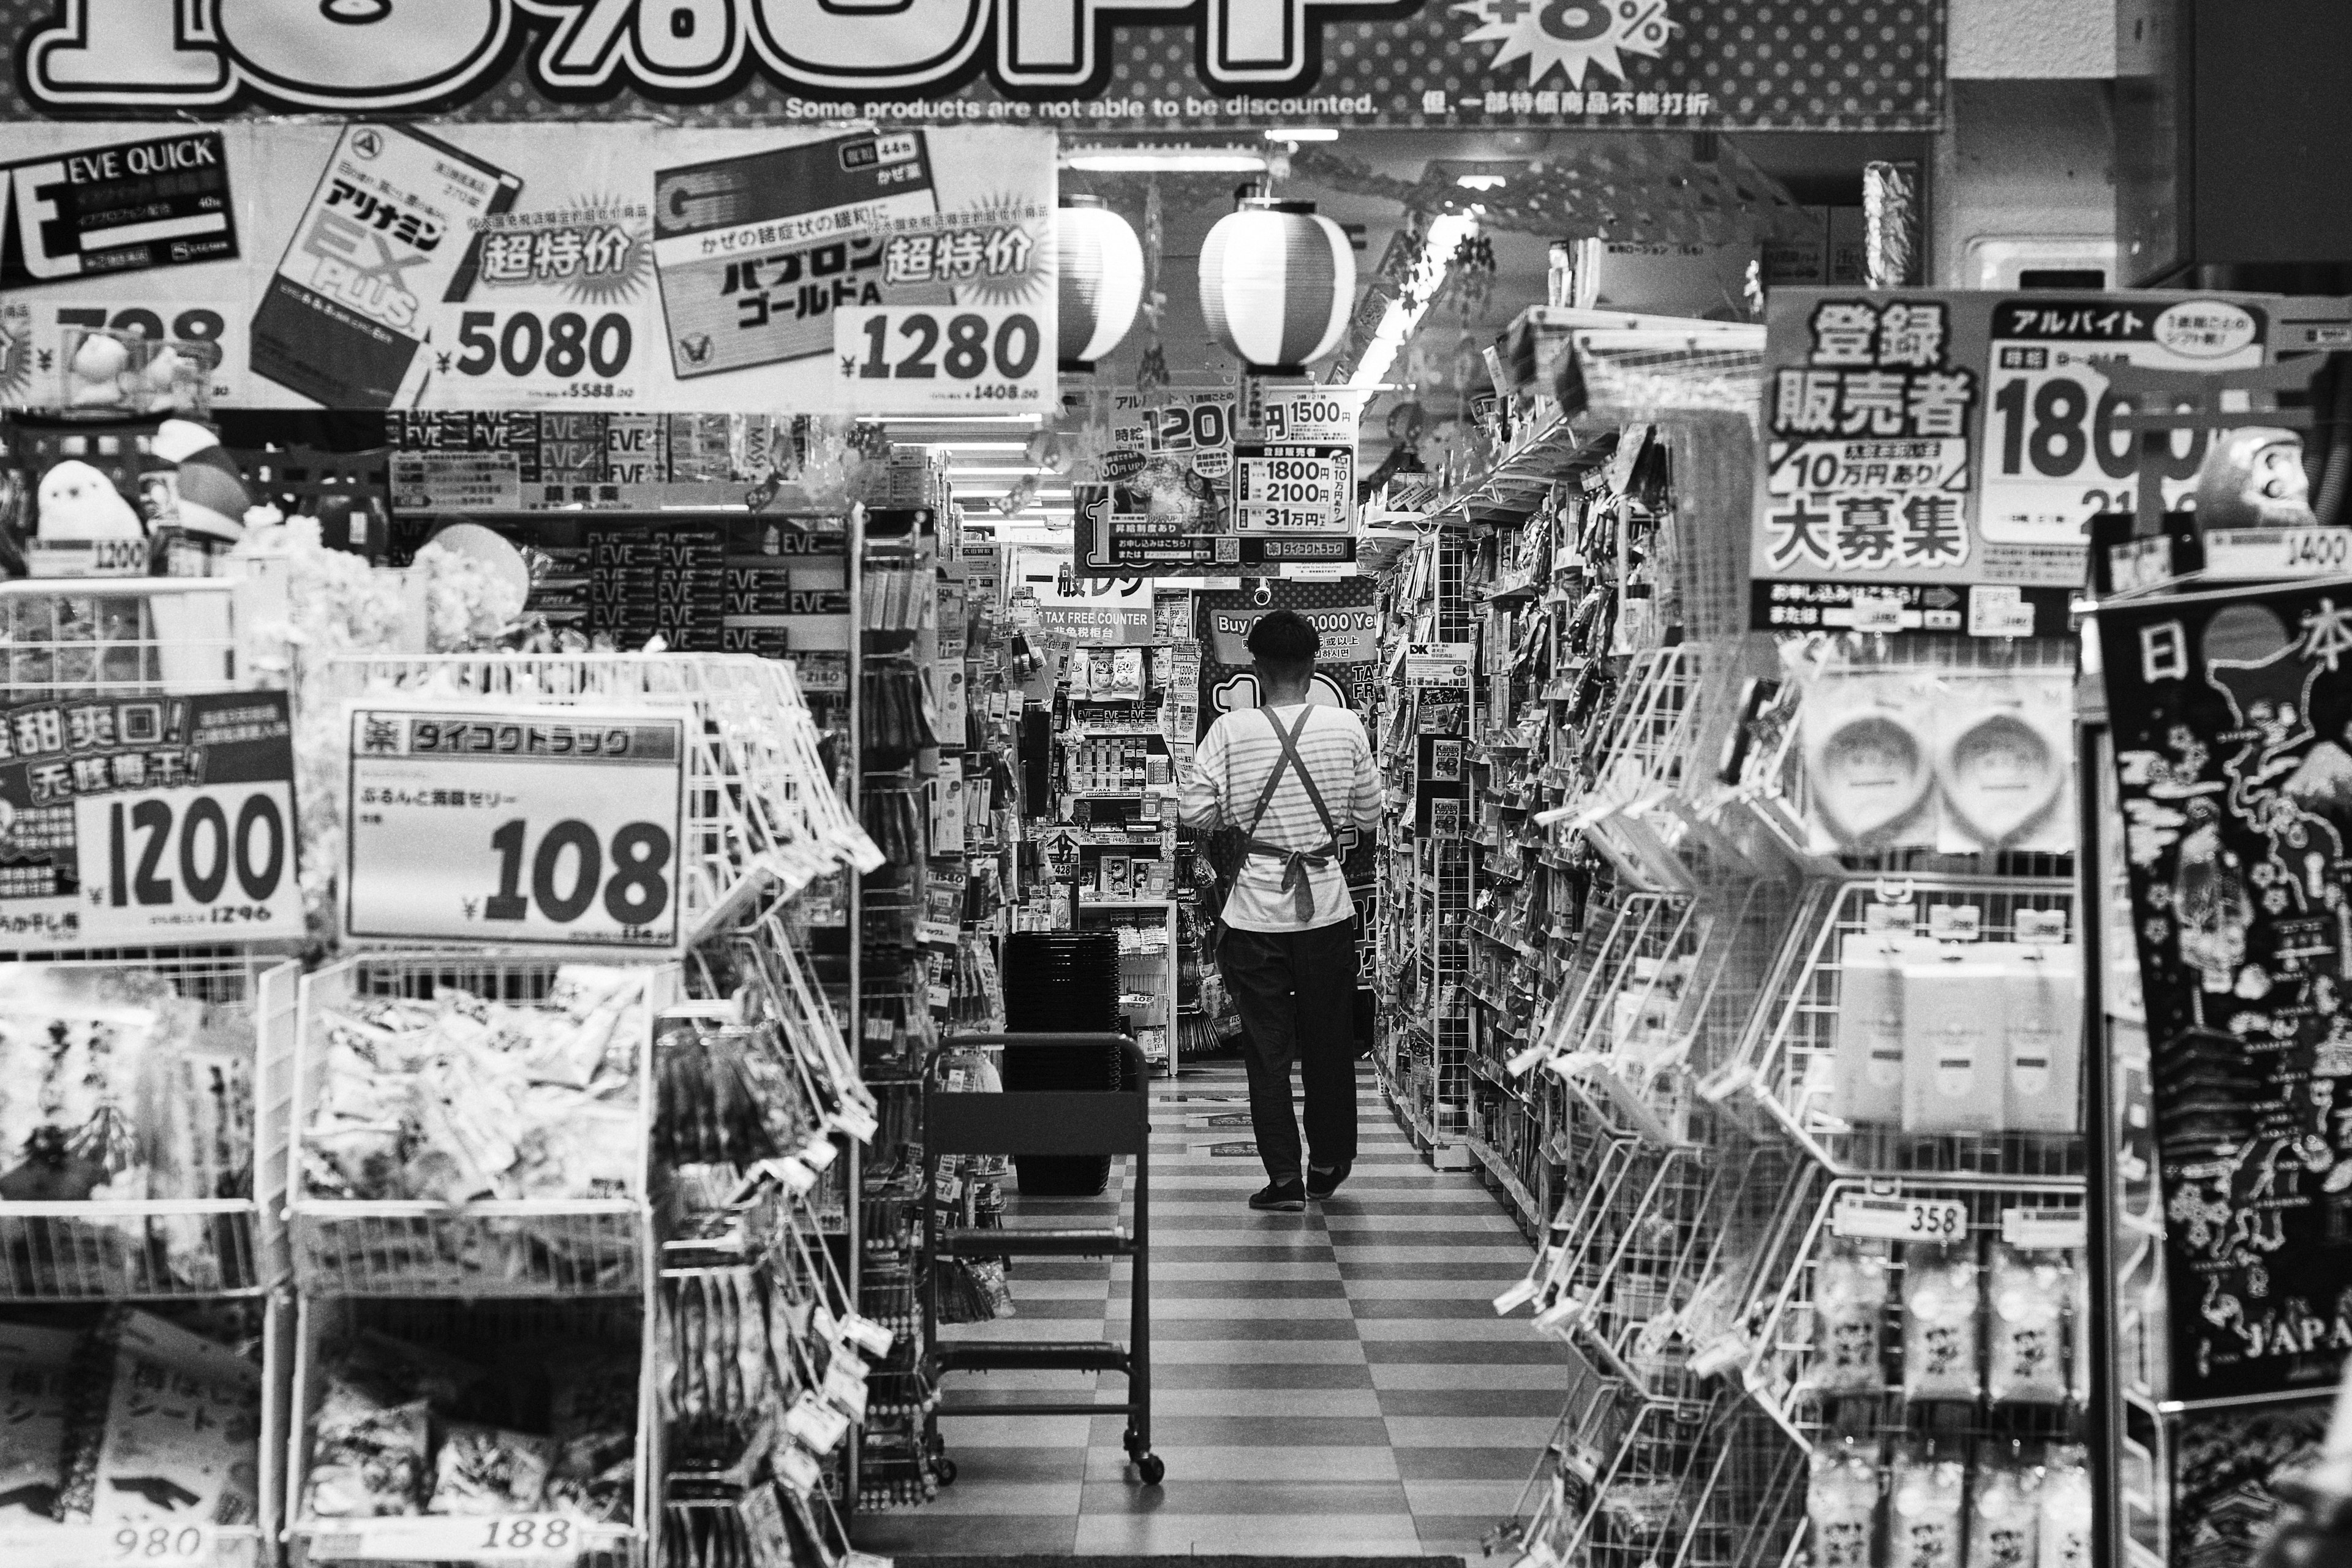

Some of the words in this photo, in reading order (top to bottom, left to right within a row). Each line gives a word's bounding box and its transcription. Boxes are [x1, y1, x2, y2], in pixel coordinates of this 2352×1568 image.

[786, 97, 856, 119] Some
[864, 97, 980, 120] products
[987, 102, 1031, 118] are
[1039, 99, 1081, 118] not
[1090, 97, 1145, 118] able
[1154, 100, 1179, 117] to
[1186, 97, 1218, 116] be
[1227, 95, 1378, 116] discounted.
[69, 151, 122, 184] EVE
[127, 138, 217, 175] QUICK
[325, 178, 441, 252] アリナミン
[721, 237, 884, 296] パブロン
[311, 257, 420, 329] PLUS
[2012, 309, 2144, 335] アルバイト
[1811, 303, 1943, 366] 登録
[1774, 369, 1972, 435] 販売者
[609, 429, 646, 451] EVE
[1115, 428, 1144, 442] 時給
[1264, 447, 1316, 457] 登録販売者
[1771, 495, 1961, 560] 大募集
[783, 533, 819, 552] EVE
[1118, 539, 1191, 548] お申し込みはこちら!
[726, 569, 761, 589] EVE
[727, 592, 760, 612] EVE
[791, 592, 827, 612] EVE
[1046, 611, 1065, 624] TAX
[1068, 611, 1094, 624] FREE
[1097, 612, 1147, 625] COUNTER
[1218, 616, 1248, 633] Buy
[723, 629, 758, 650] EVE
[2140, 618, 2188, 684] 日
[1104, 710, 1119, 718] EVE
[1131, 710, 1145, 718] EVE
[1055, 865, 1071, 875] 428
[1910, 1205, 1958, 1233] 358
[2244, 1314, 2352, 1359] JAPA
[116, 1528, 201, 1557] 980
[481, 1519, 571, 1549] 188
